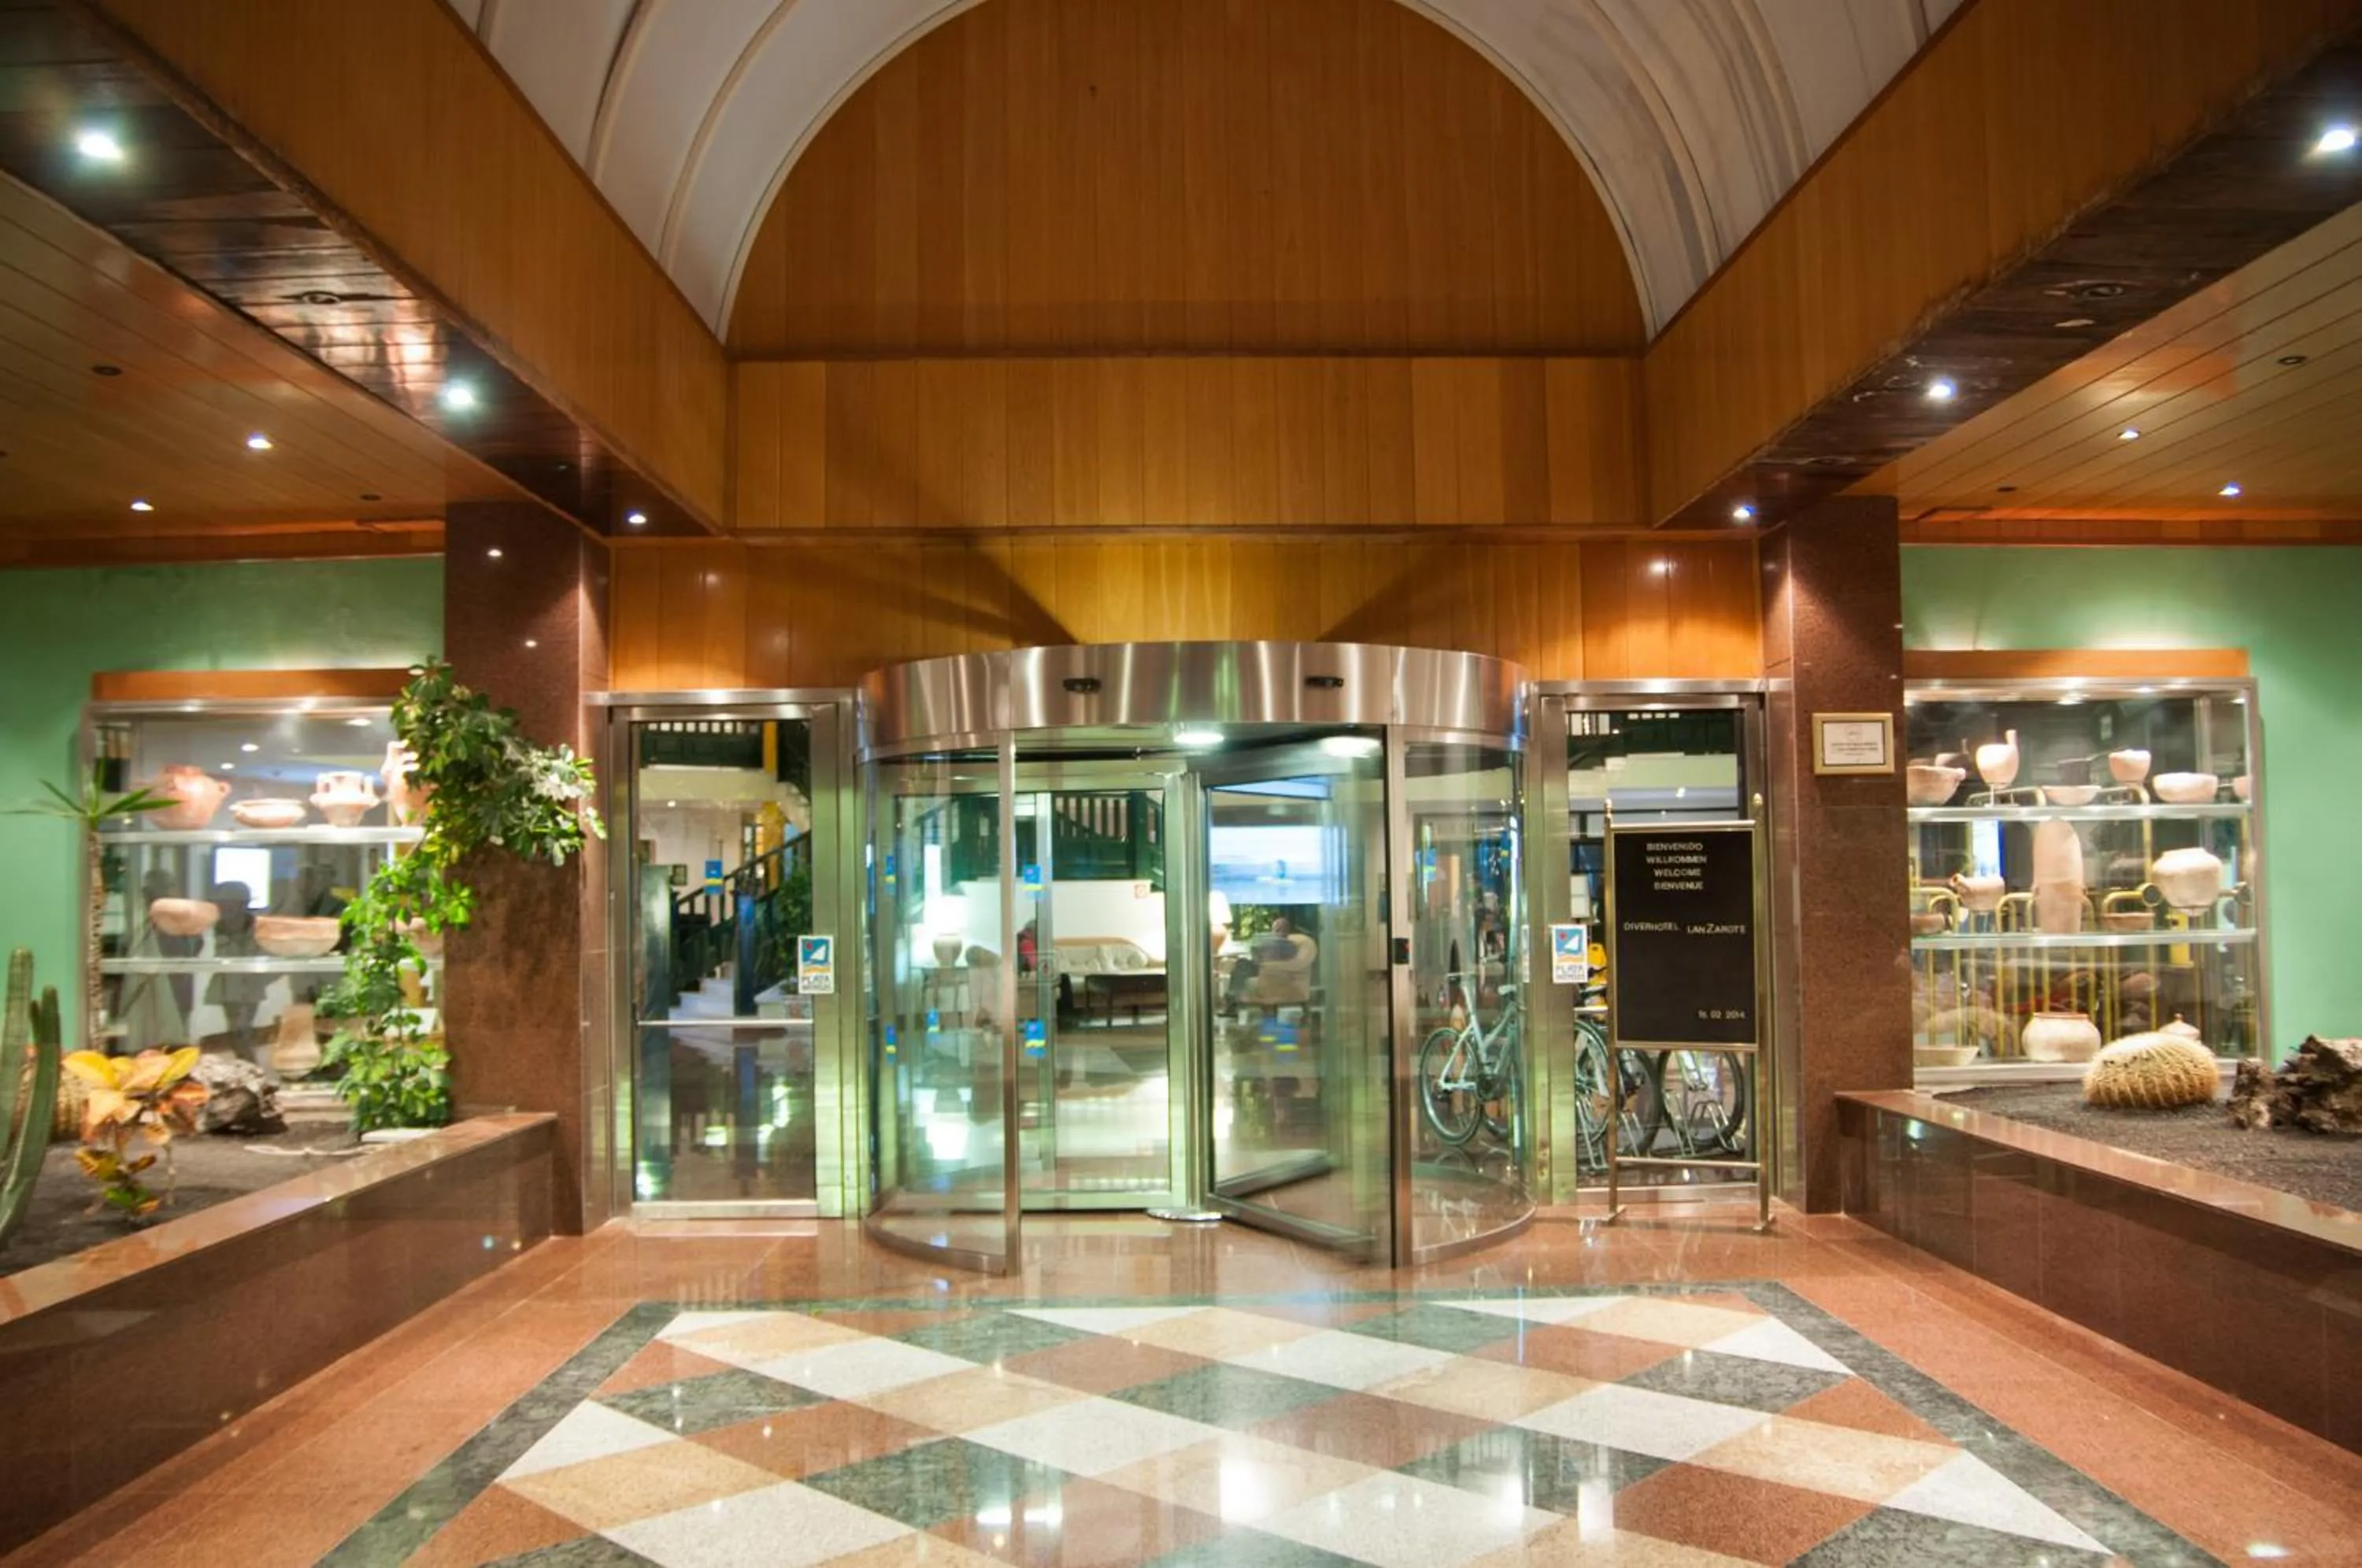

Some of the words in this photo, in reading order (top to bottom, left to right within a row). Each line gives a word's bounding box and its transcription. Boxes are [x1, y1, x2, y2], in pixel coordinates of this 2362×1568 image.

[1646, 842, 1703, 851] BIENVENIDO
[1653, 868, 1701, 877] WELCOME
[1654, 881, 1703, 890] BIENVENUE
[1623, 922, 1680, 931] DIVERHOTEL
